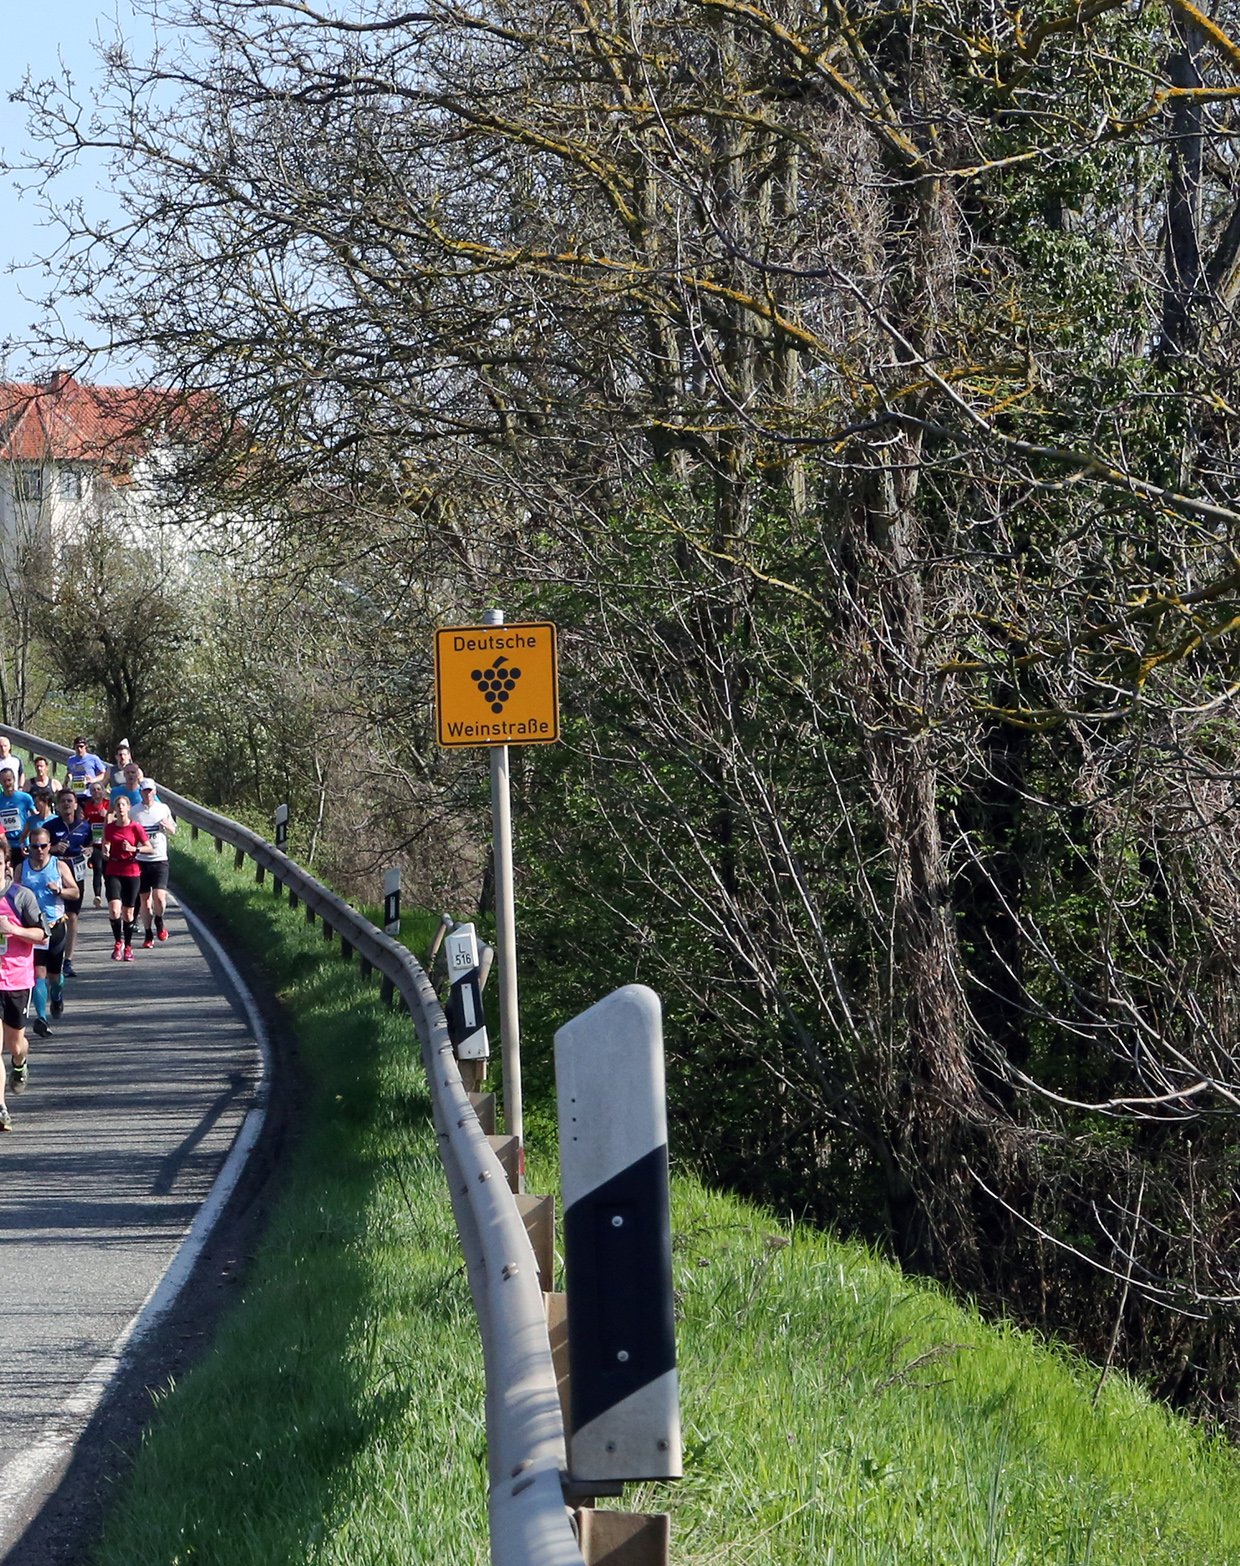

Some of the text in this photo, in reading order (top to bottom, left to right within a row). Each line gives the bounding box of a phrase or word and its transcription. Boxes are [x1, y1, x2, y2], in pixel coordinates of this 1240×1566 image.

[453, 634, 537, 652] Deutsche
[447, 718, 549, 737] Weinstraße
[458, 943, 466, 953] L
[455, 953, 472, 965] 516
